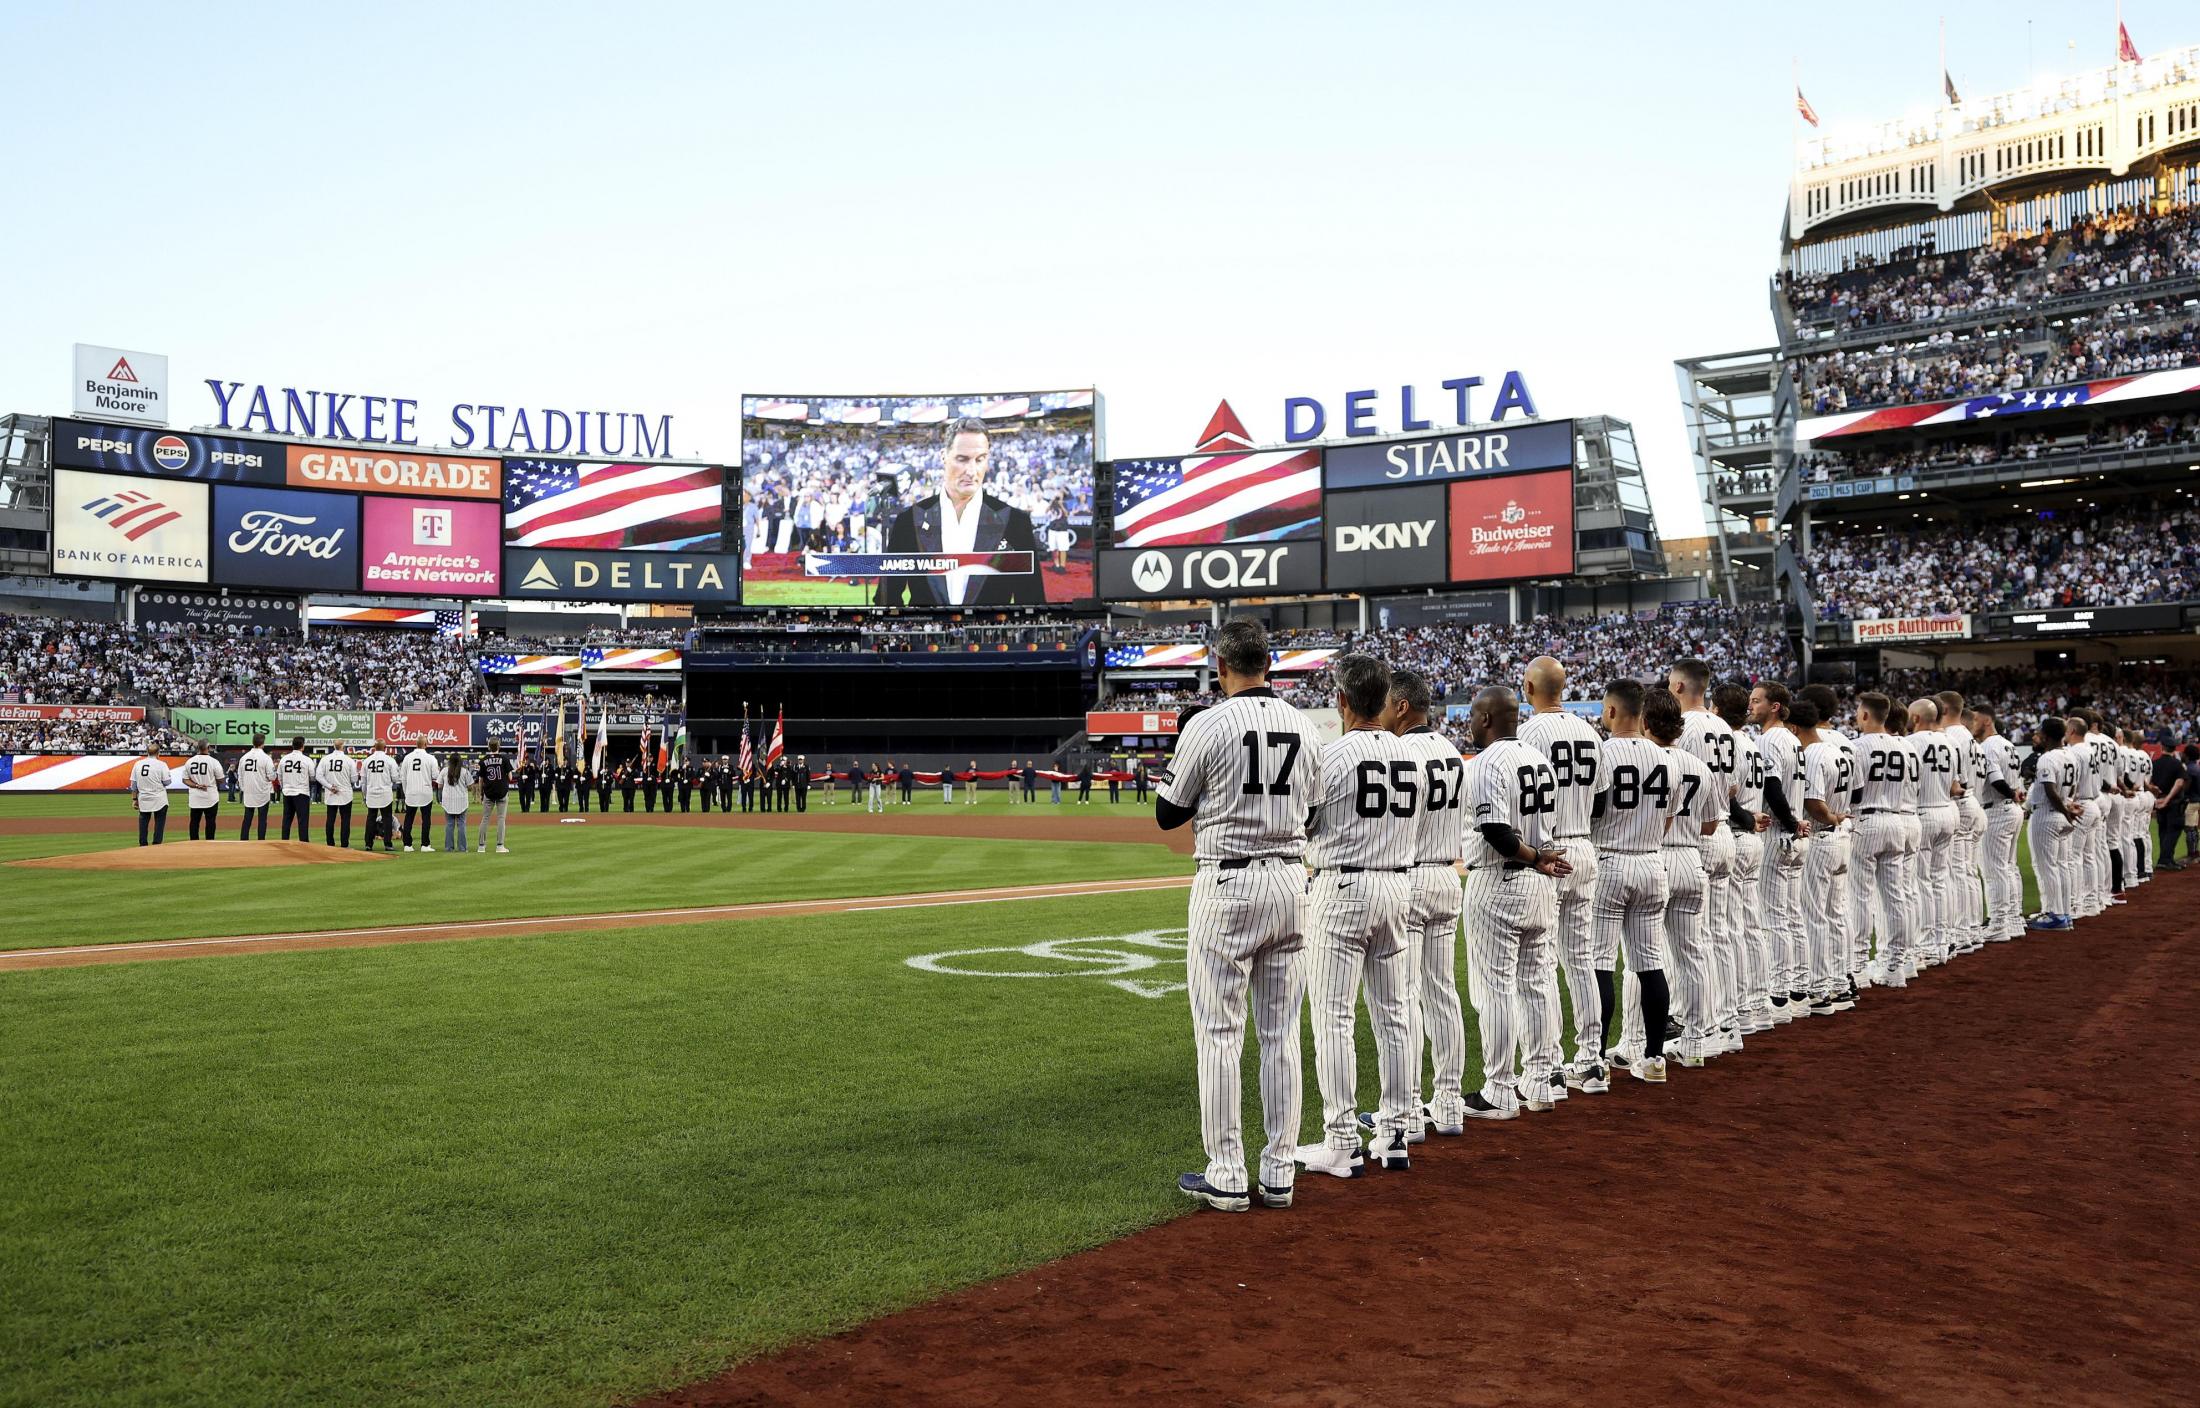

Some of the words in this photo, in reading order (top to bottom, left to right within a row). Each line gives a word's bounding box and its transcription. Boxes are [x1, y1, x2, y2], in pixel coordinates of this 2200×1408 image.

[86, 380, 158, 401] Benjamin
[95, 396, 146, 412] Moore
[1285, 370, 1538, 443] DELTA
[205, 379, 418, 446] YANKEE
[450, 403, 674, 459] STADIUM
[77, 437, 132, 455] PEPSI
[156, 448, 187, 459] PEPSI
[211, 451, 262, 468] PEPSI
[1385, 434, 1509, 479] STARR
[300, 454, 492, 490] GATORADE
[228, 510, 344, 560] Ford
[1336, 520, 1436, 552] DKNY
[1471, 523, 1554, 543] Budweiser
[1469, 543, 1500, 555] Made
[1501, 542, 1512, 554] of
[1511, 540, 1552, 552] America
[57, 549, 102, 562] BANK
[107, 552, 127, 564] OF
[131, 554, 203, 569] AMERICA
[383, 551, 480, 569] America's
[879, 559, 916, 571] JAMES
[916, 558, 959, 571] VALENTI
[1183, 547, 1288, 589] razr
[367, 565, 411, 580] Best
[413, 567, 496, 584] Network
[574, 560, 724, 590] DELTA
[185, 608, 202, 617] New
[202, 609, 221, 621] York
[222, 609, 253, 621] Yankees
[1859, 623, 1894, 636] Parts
[1898, 618, 1963, 634] Authority
[557, 687, 584, 695] TERRAC
[1273, 681, 1296, 689] TOYO
[12, 707, 41, 718] Farm
[76, 708, 105, 720] State
[105, 709, 132, 720] Farm
[278, 712, 317, 723] Morningside
[586, 714, 602, 722] WATC
[176, 719, 222, 735] Uber
[226, 720, 270, 735] Eats
[352, 721, 370, 729] Circle
[387, 719, 458, 744] Chick-fil-A
[506, 720, 541, 736] coup
[1161, 719, 1178, 727] TOY
[484, 757, 503, 766] PIAZZA
[1704, 732, 1735, 774] 33
[1922, 744, 1952, 772] 43
[141, 764, 150, 777] 6
[190, 762, 208, 776] 20
[244, 760, 258, 772] 21
[285, 760, 301, 773] 24
[329, 759, 343, 772] 18
[368, 760, 385, 773] 42
[413, 759, 421, 771] 2
[1242, 731, 1301, 796] 17
[1551, 740, 1597, 788] 85
[1869, 750, 1905, 782] 29
[486, 766, 502, 781] 31
[1356, 761, 1418, 819] 65
[1425, 758, 1464, 812] 67
[1517, 763, 1555, 816] 82
[1613, 764, 1670, 810] 84
[1677, 774, 1701, 817] 7
